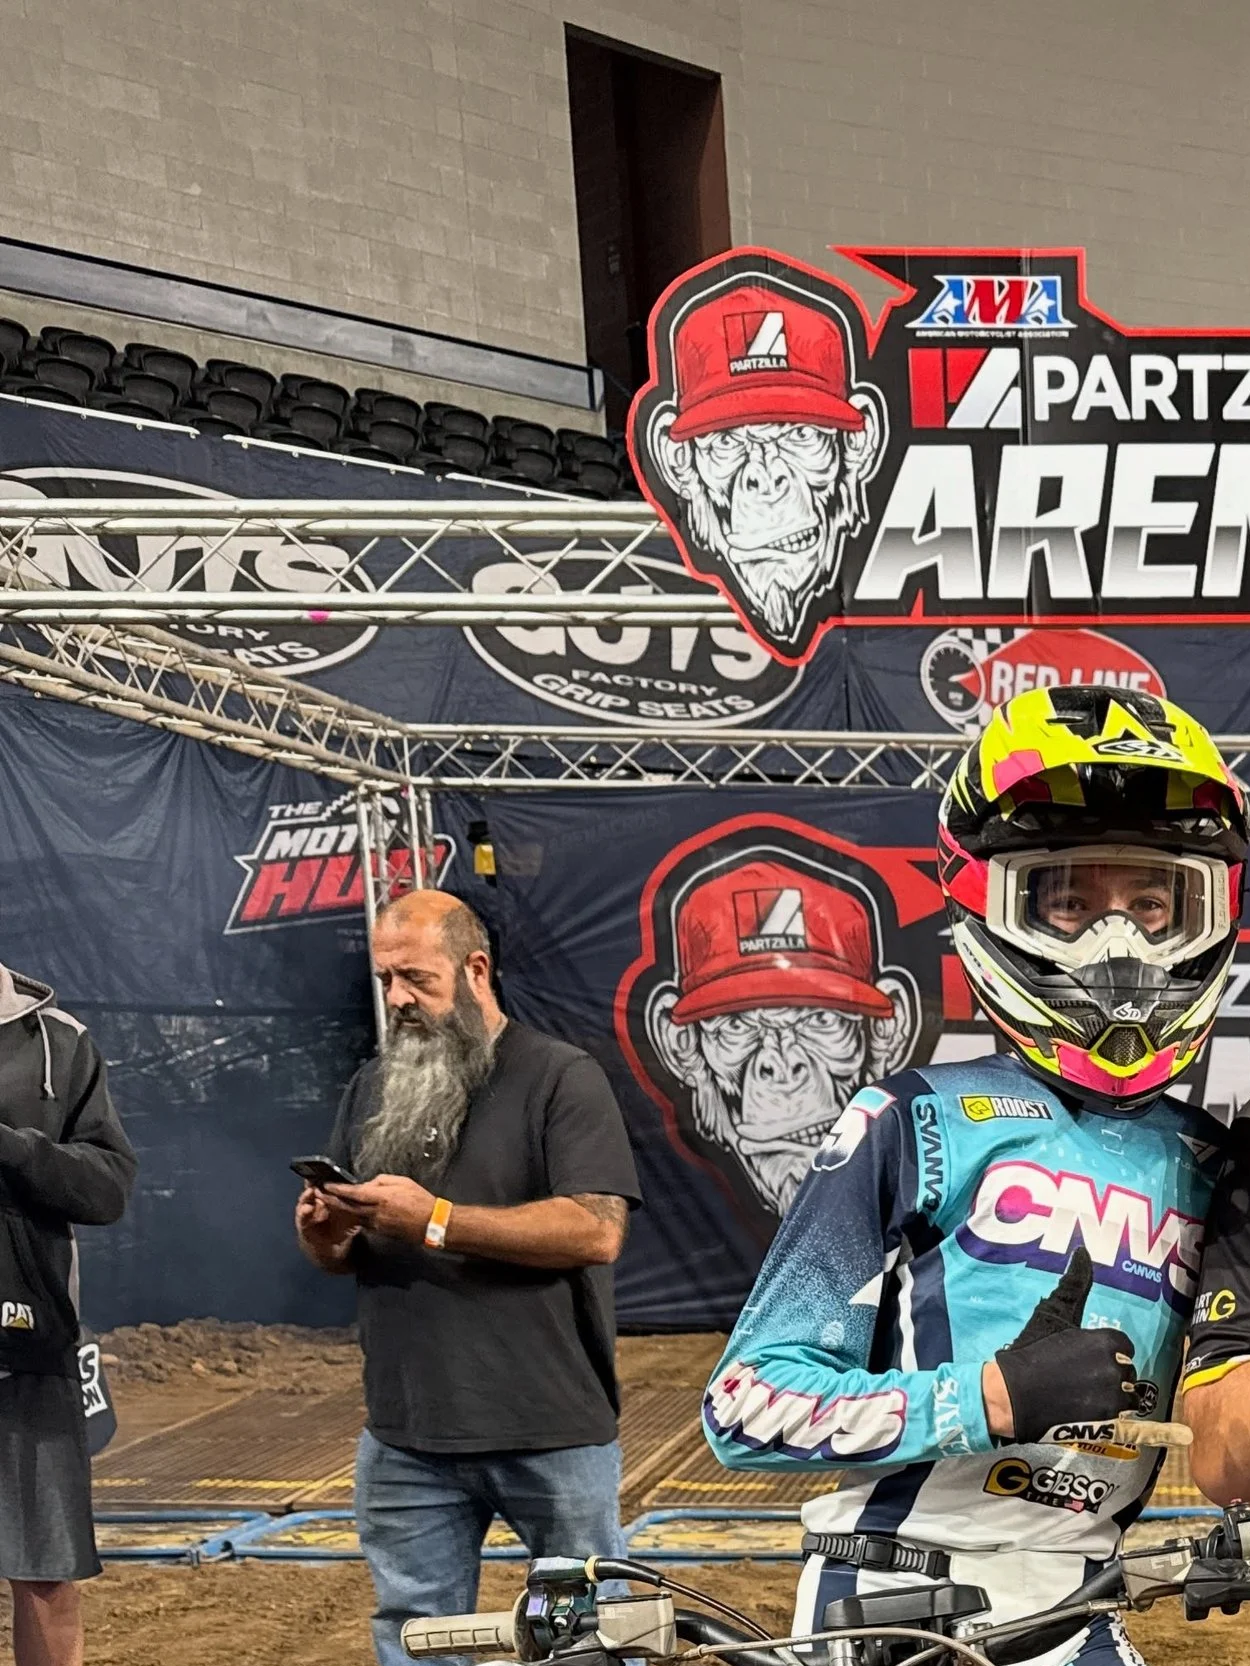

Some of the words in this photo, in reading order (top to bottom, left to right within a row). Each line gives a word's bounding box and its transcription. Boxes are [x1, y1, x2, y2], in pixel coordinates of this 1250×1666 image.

[905, 275, 1079, 328] AMA
[916, 330, 956, 338] AMERICAN
[729, 358, 788, 373] PARTZILLA
[532, 673, 631, 712] GRIP
[637, 695, 756, 719] SEATS
[571, 669, 718, 697] FACTORY
[269, 801, 323, 819] THE
[740, 936, 806, 953] PARTZILLA
[989, 1097, 1049, 1118] ROOST
[916, 1102, 943, 1212] CANVAS
[1121, 1258, 1163, 1284] CANVAS
[1, 1301, 35, 1330] CAT
[1052, 1423, 1115, 1441] CNVS
[1031, 1469, 1118, 1505] GIBSO
